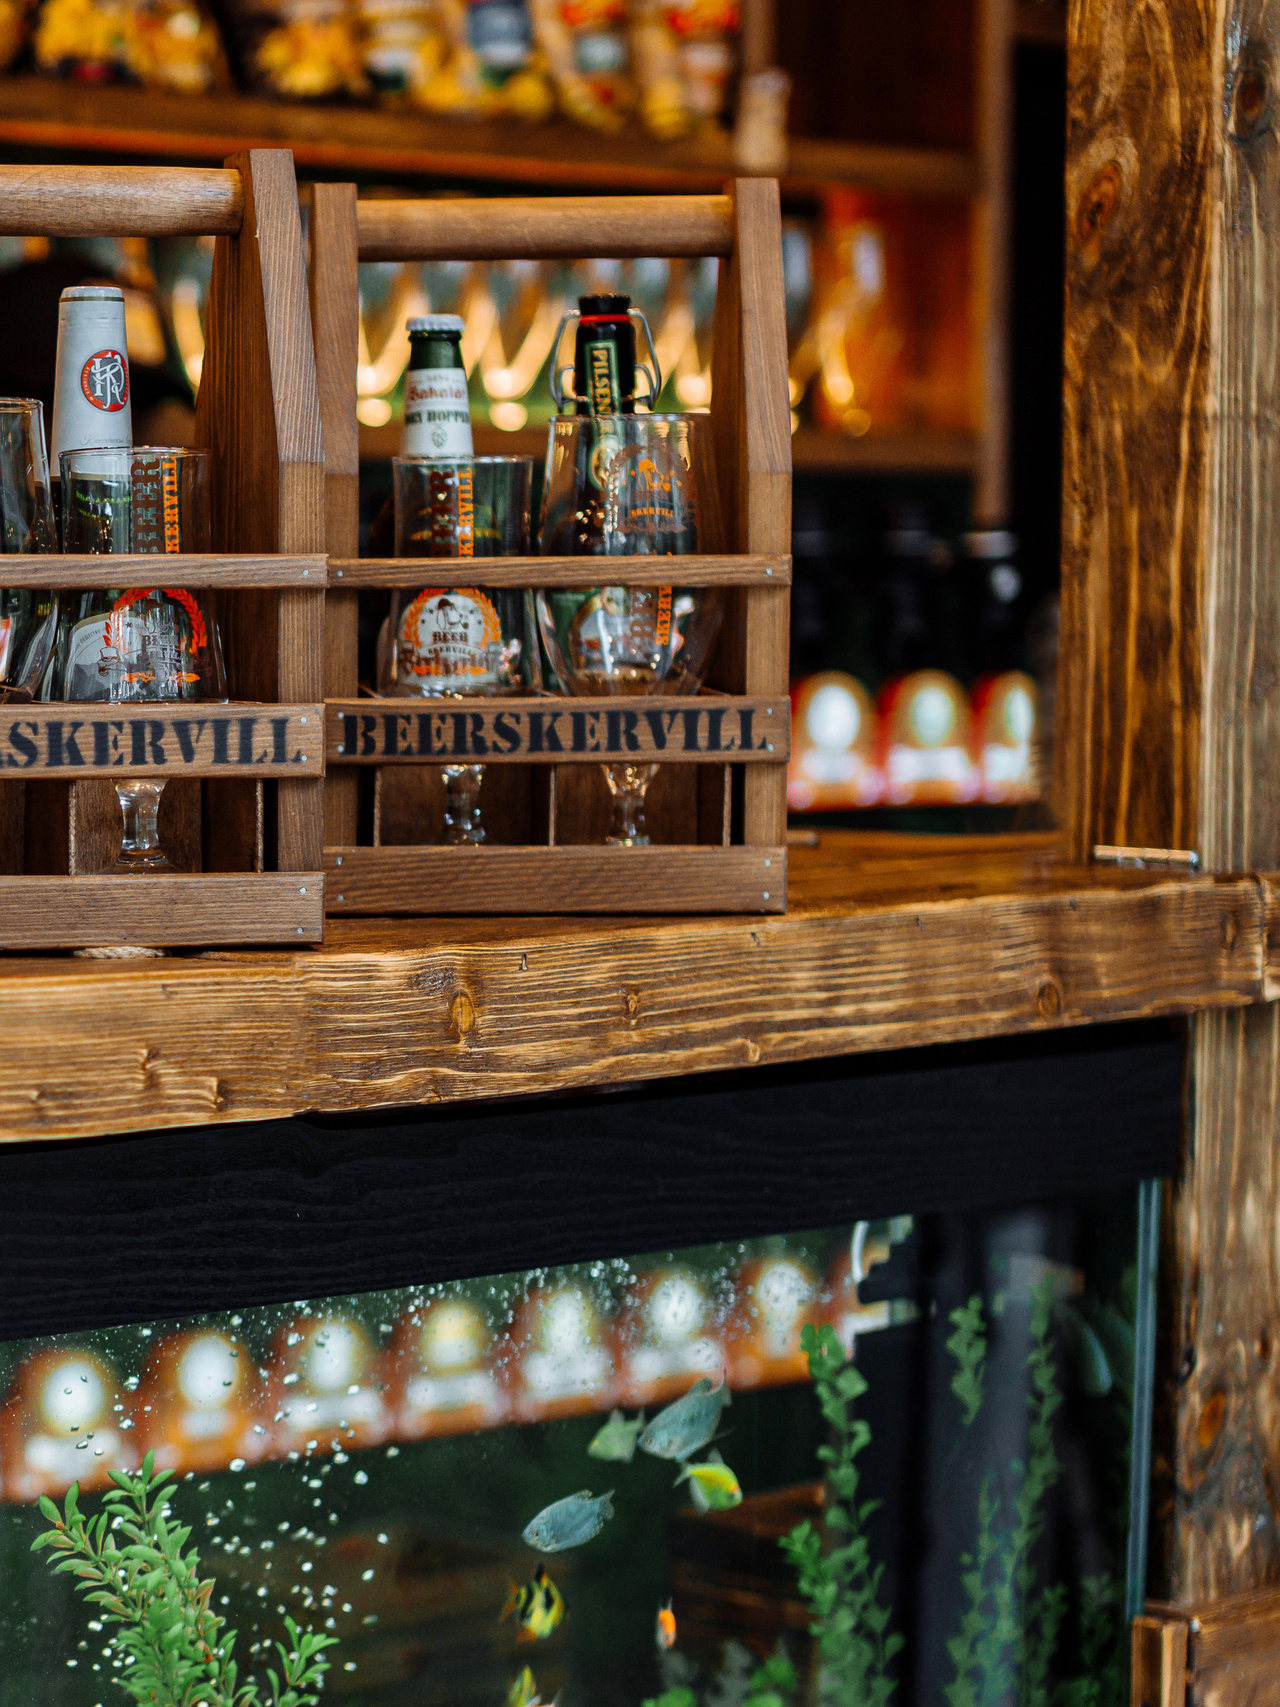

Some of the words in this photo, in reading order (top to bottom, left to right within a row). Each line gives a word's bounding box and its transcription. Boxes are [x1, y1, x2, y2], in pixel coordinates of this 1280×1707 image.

[162, 457, 180, 554] KERVILL
[458, 467, 474, 558] KERVILL
[655, 586, 673, 646] SKERV
[343, 708, 769, 756] BEERSKERVILL
